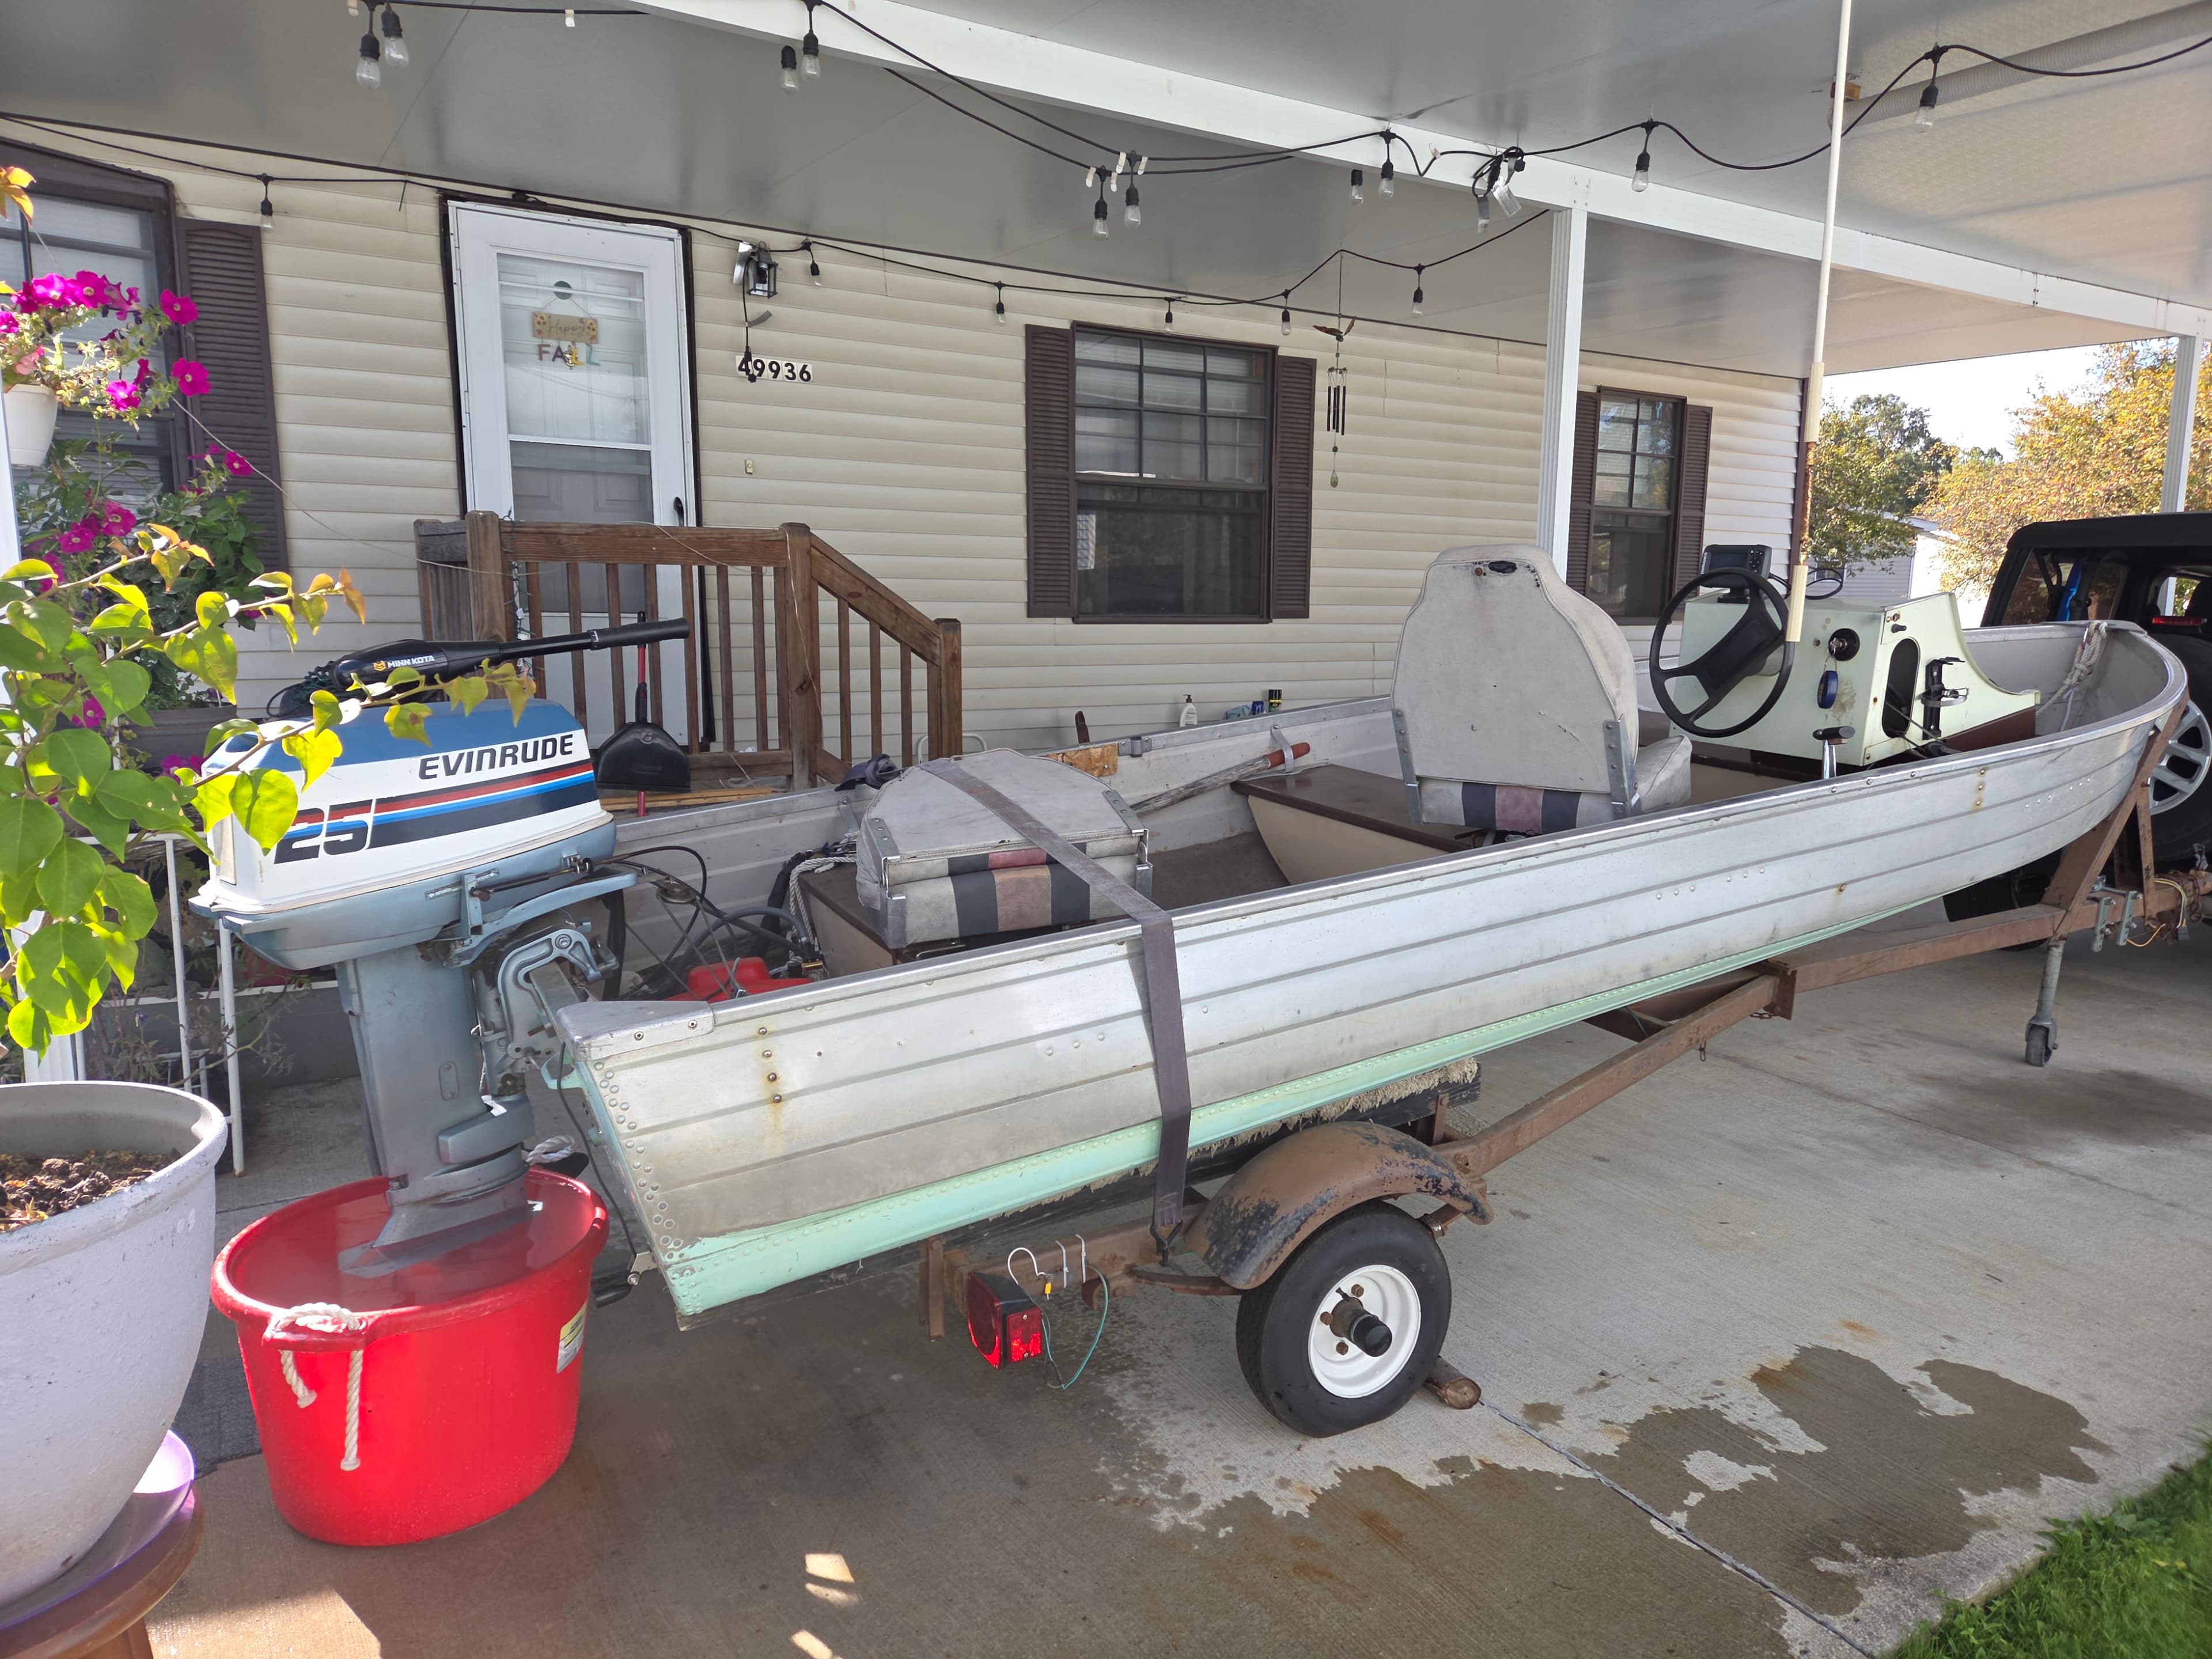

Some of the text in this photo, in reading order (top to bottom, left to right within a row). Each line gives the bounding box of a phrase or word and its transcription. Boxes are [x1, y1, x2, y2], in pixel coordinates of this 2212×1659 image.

[537, 344, 601, 366] FALL
[738, 357, 812, 382] 49936
[387, 655, 435, 668] MINN KOTA
[419, 733, 573, 780] EVINRUDE
[274, 798, 373, 864] 25
